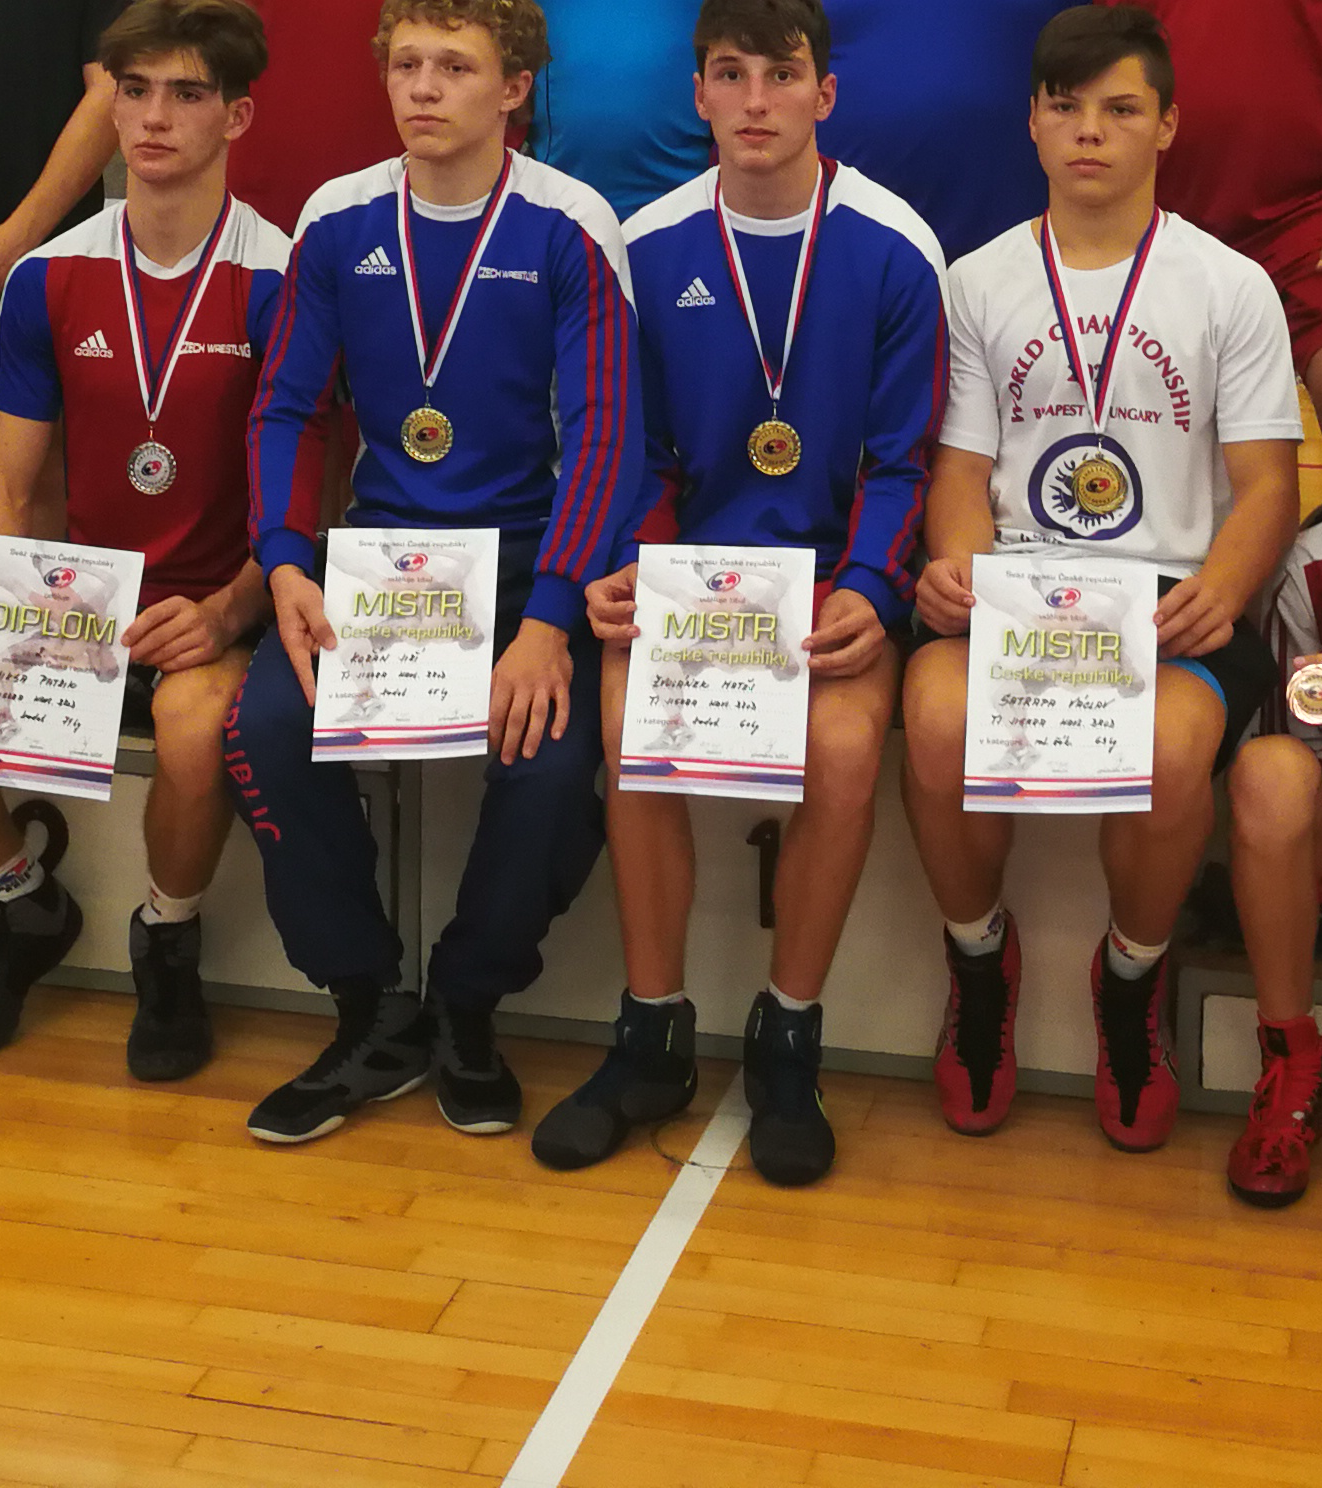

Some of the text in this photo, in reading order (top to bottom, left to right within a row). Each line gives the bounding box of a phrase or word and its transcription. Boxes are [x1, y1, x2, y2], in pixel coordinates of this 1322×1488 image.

[355, 263, 397, 276] adidas
[676, 295, 716, 308] adidas
[74, 345, 114, 359] adidas
[1008, 338, 1044, 423] WORLD
[1109, 406, 1163, 424] UNGARY
[352, 589, 465, 619] MISTR
[662, 610, 778, 643] MISTR
[1001, 627, 1123, 662] MISTR
[746, 818, 780, 929] 1
